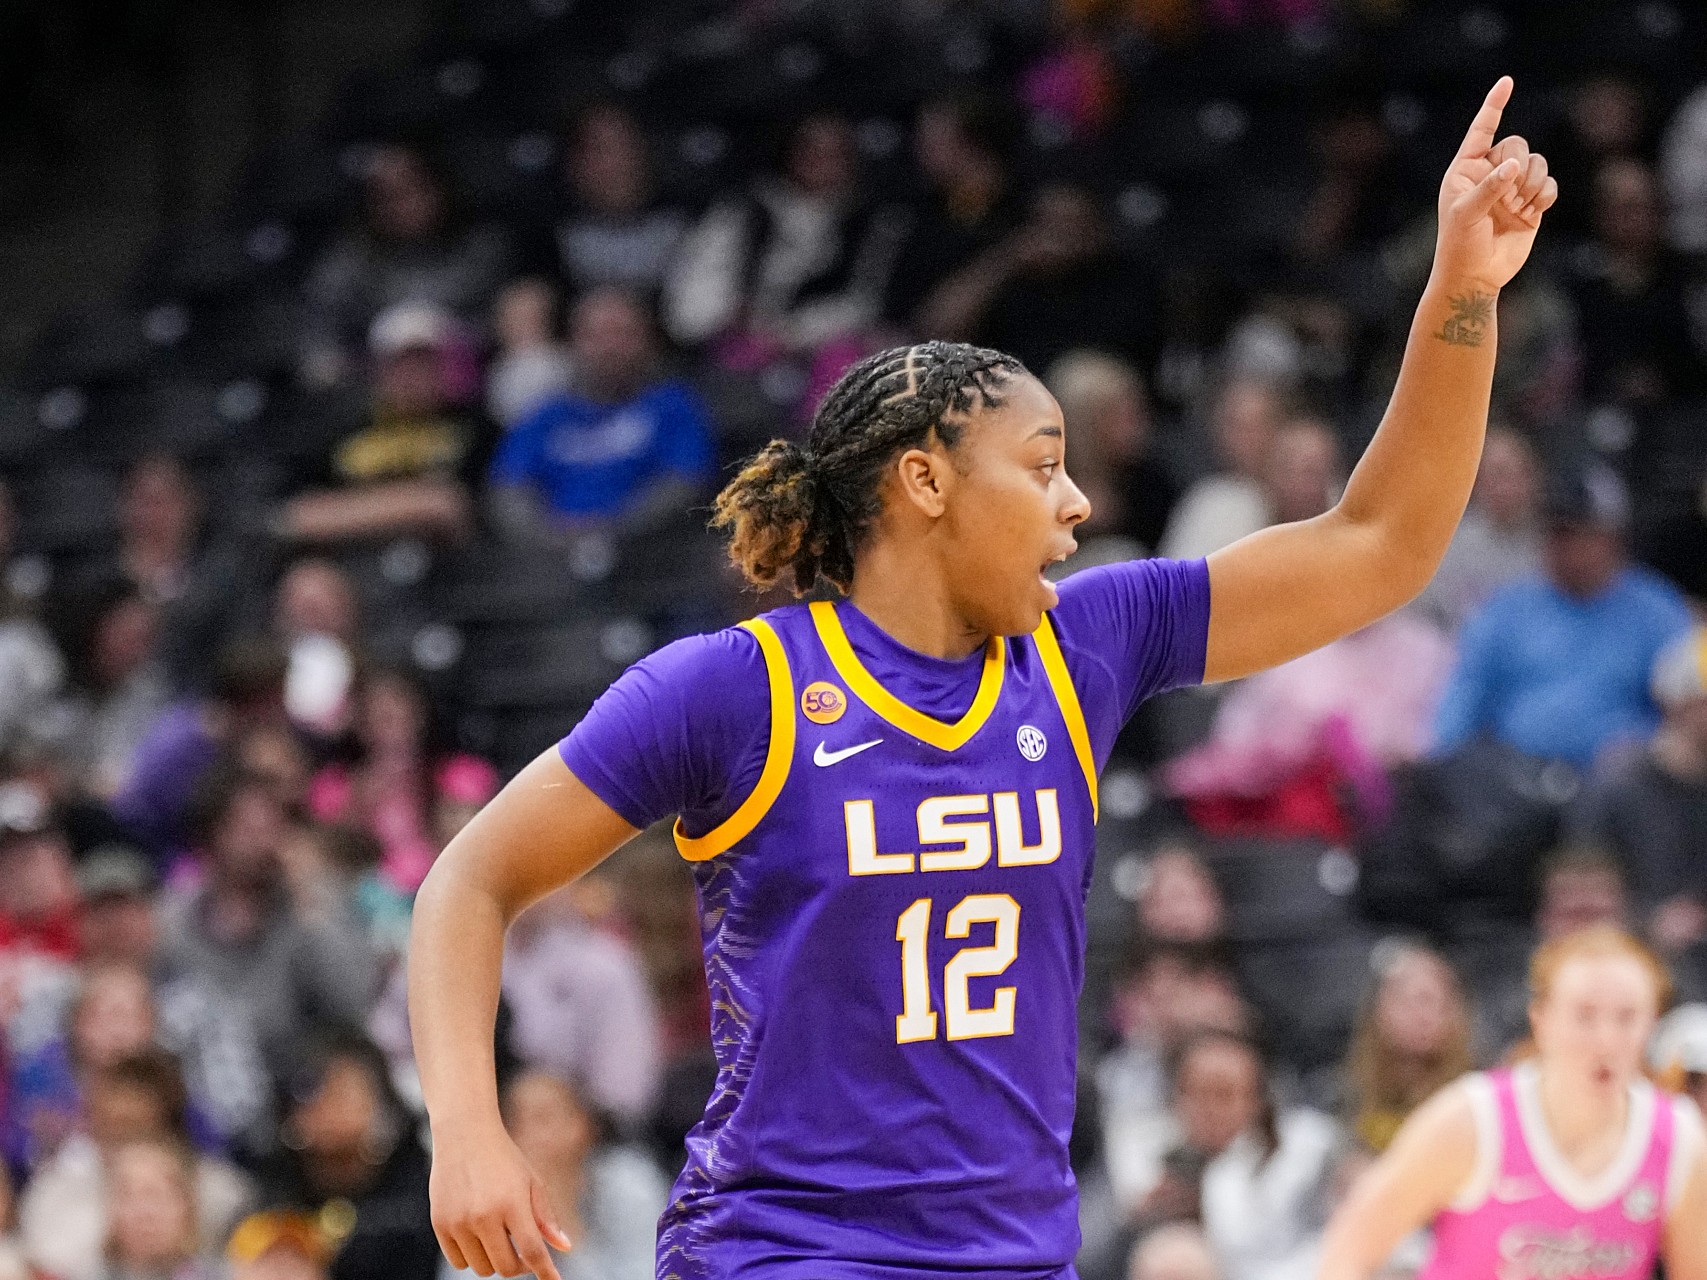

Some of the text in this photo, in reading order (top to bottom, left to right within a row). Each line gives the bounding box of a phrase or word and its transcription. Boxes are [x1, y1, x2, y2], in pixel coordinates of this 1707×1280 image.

[806, 691, 838, 713] 50
[1019, 728, 1044, 758] SEC
[844, 788, 1062, 876] LSU
[896, 893, 1021, 1043] 12
